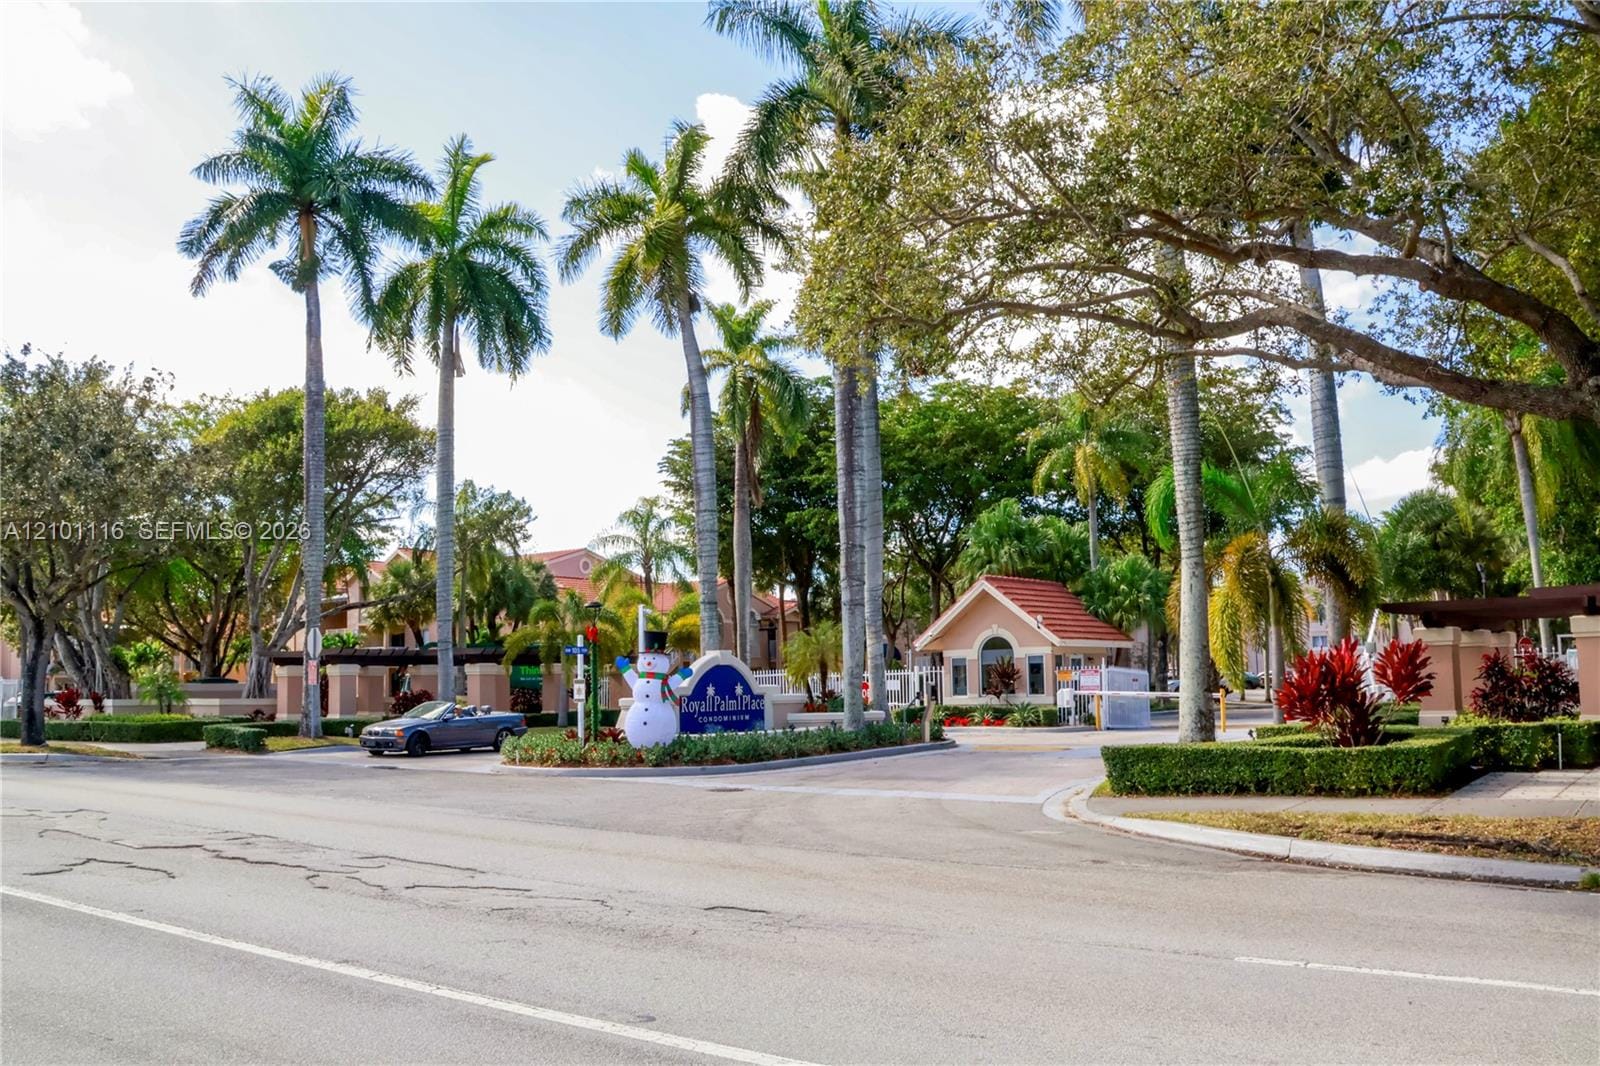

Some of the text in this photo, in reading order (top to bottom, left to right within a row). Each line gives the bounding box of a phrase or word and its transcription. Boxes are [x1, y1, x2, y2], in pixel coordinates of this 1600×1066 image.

[681, 694, 765, 718] Royal Palm Place
[698, 714, 750, 723] CONDOMINIUM
